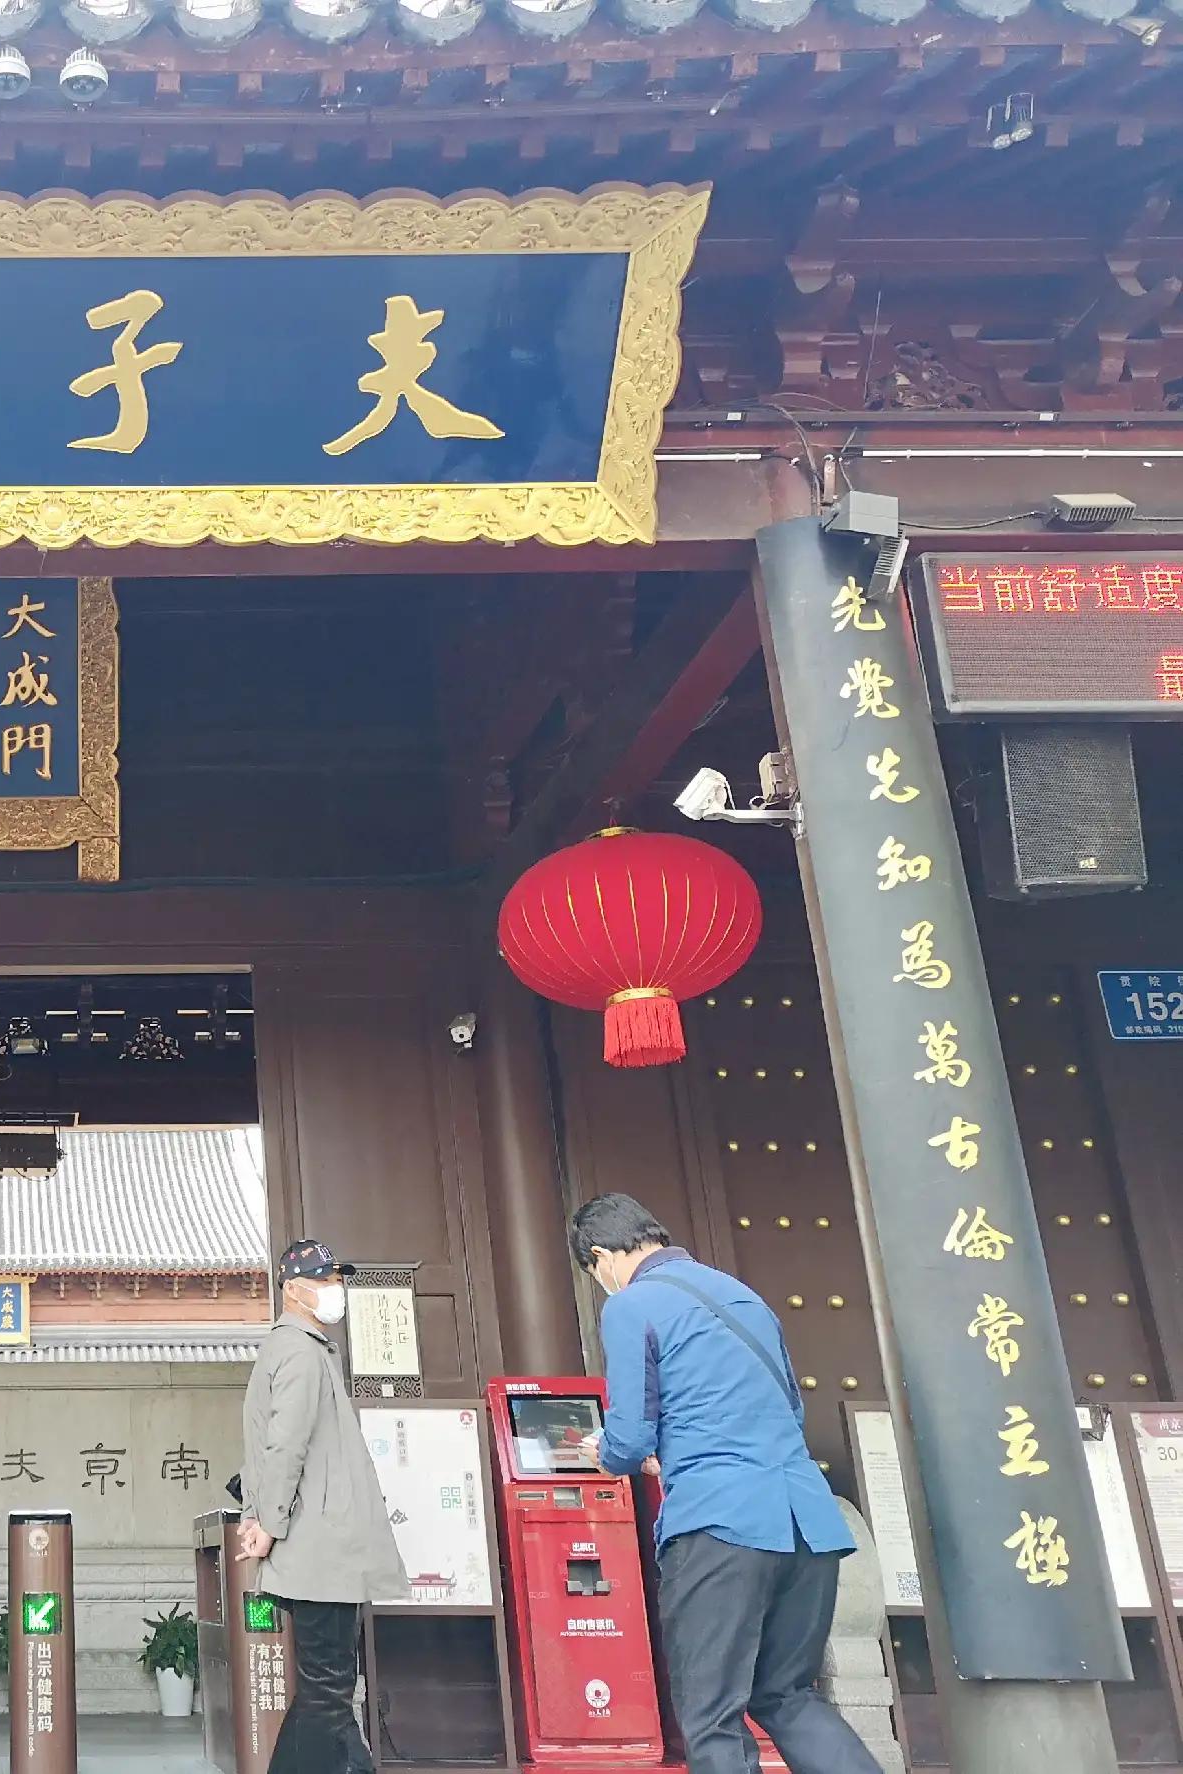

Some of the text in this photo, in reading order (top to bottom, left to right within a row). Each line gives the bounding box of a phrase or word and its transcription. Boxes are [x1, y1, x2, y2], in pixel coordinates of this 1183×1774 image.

[940, 565, 1183, 612] 当前舒适度
[1157, 1446, 1178, 1460] 30
[36, 1641, 53, 1733] 出示健康码
[257, 1643, 273, 1711] 有你有我
[272, 1642, 286, 1711] 文明健康
